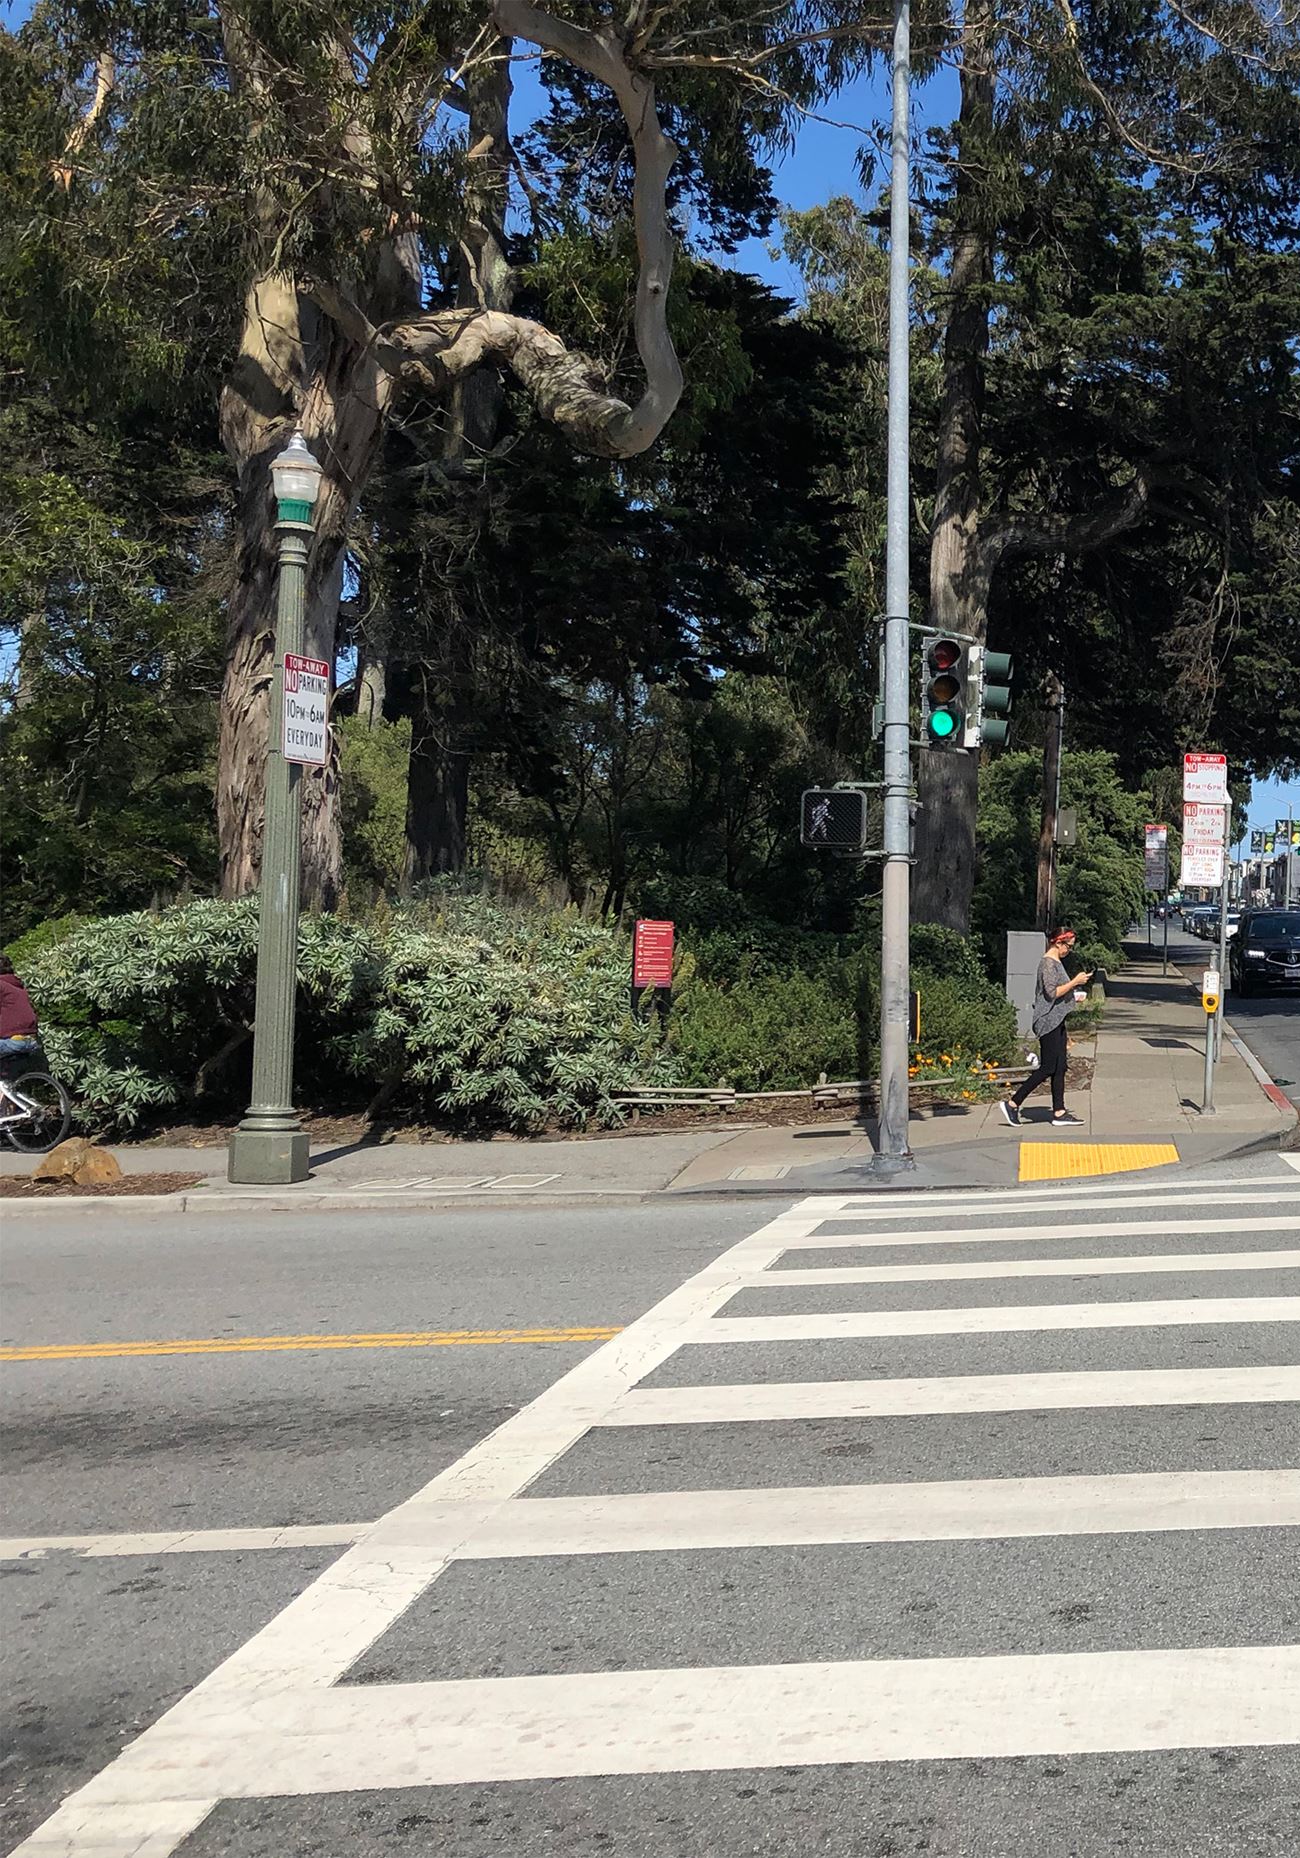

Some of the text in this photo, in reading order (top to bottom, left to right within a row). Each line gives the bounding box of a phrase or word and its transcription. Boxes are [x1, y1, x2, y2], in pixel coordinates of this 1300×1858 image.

[289, 656, 325, 675] TOW-AWAY
[286, 668, 326, 695] NO PARKING
[287, 728, 323, 748] EVERYDAY
[1189, 755, 1221, 763] TOW-AWAY
[1185, 763, 1197, 772] NO
[1185, 804, 1224, 816] NO PARKING
[1183, 845, 1220, 856] NO PARKING
